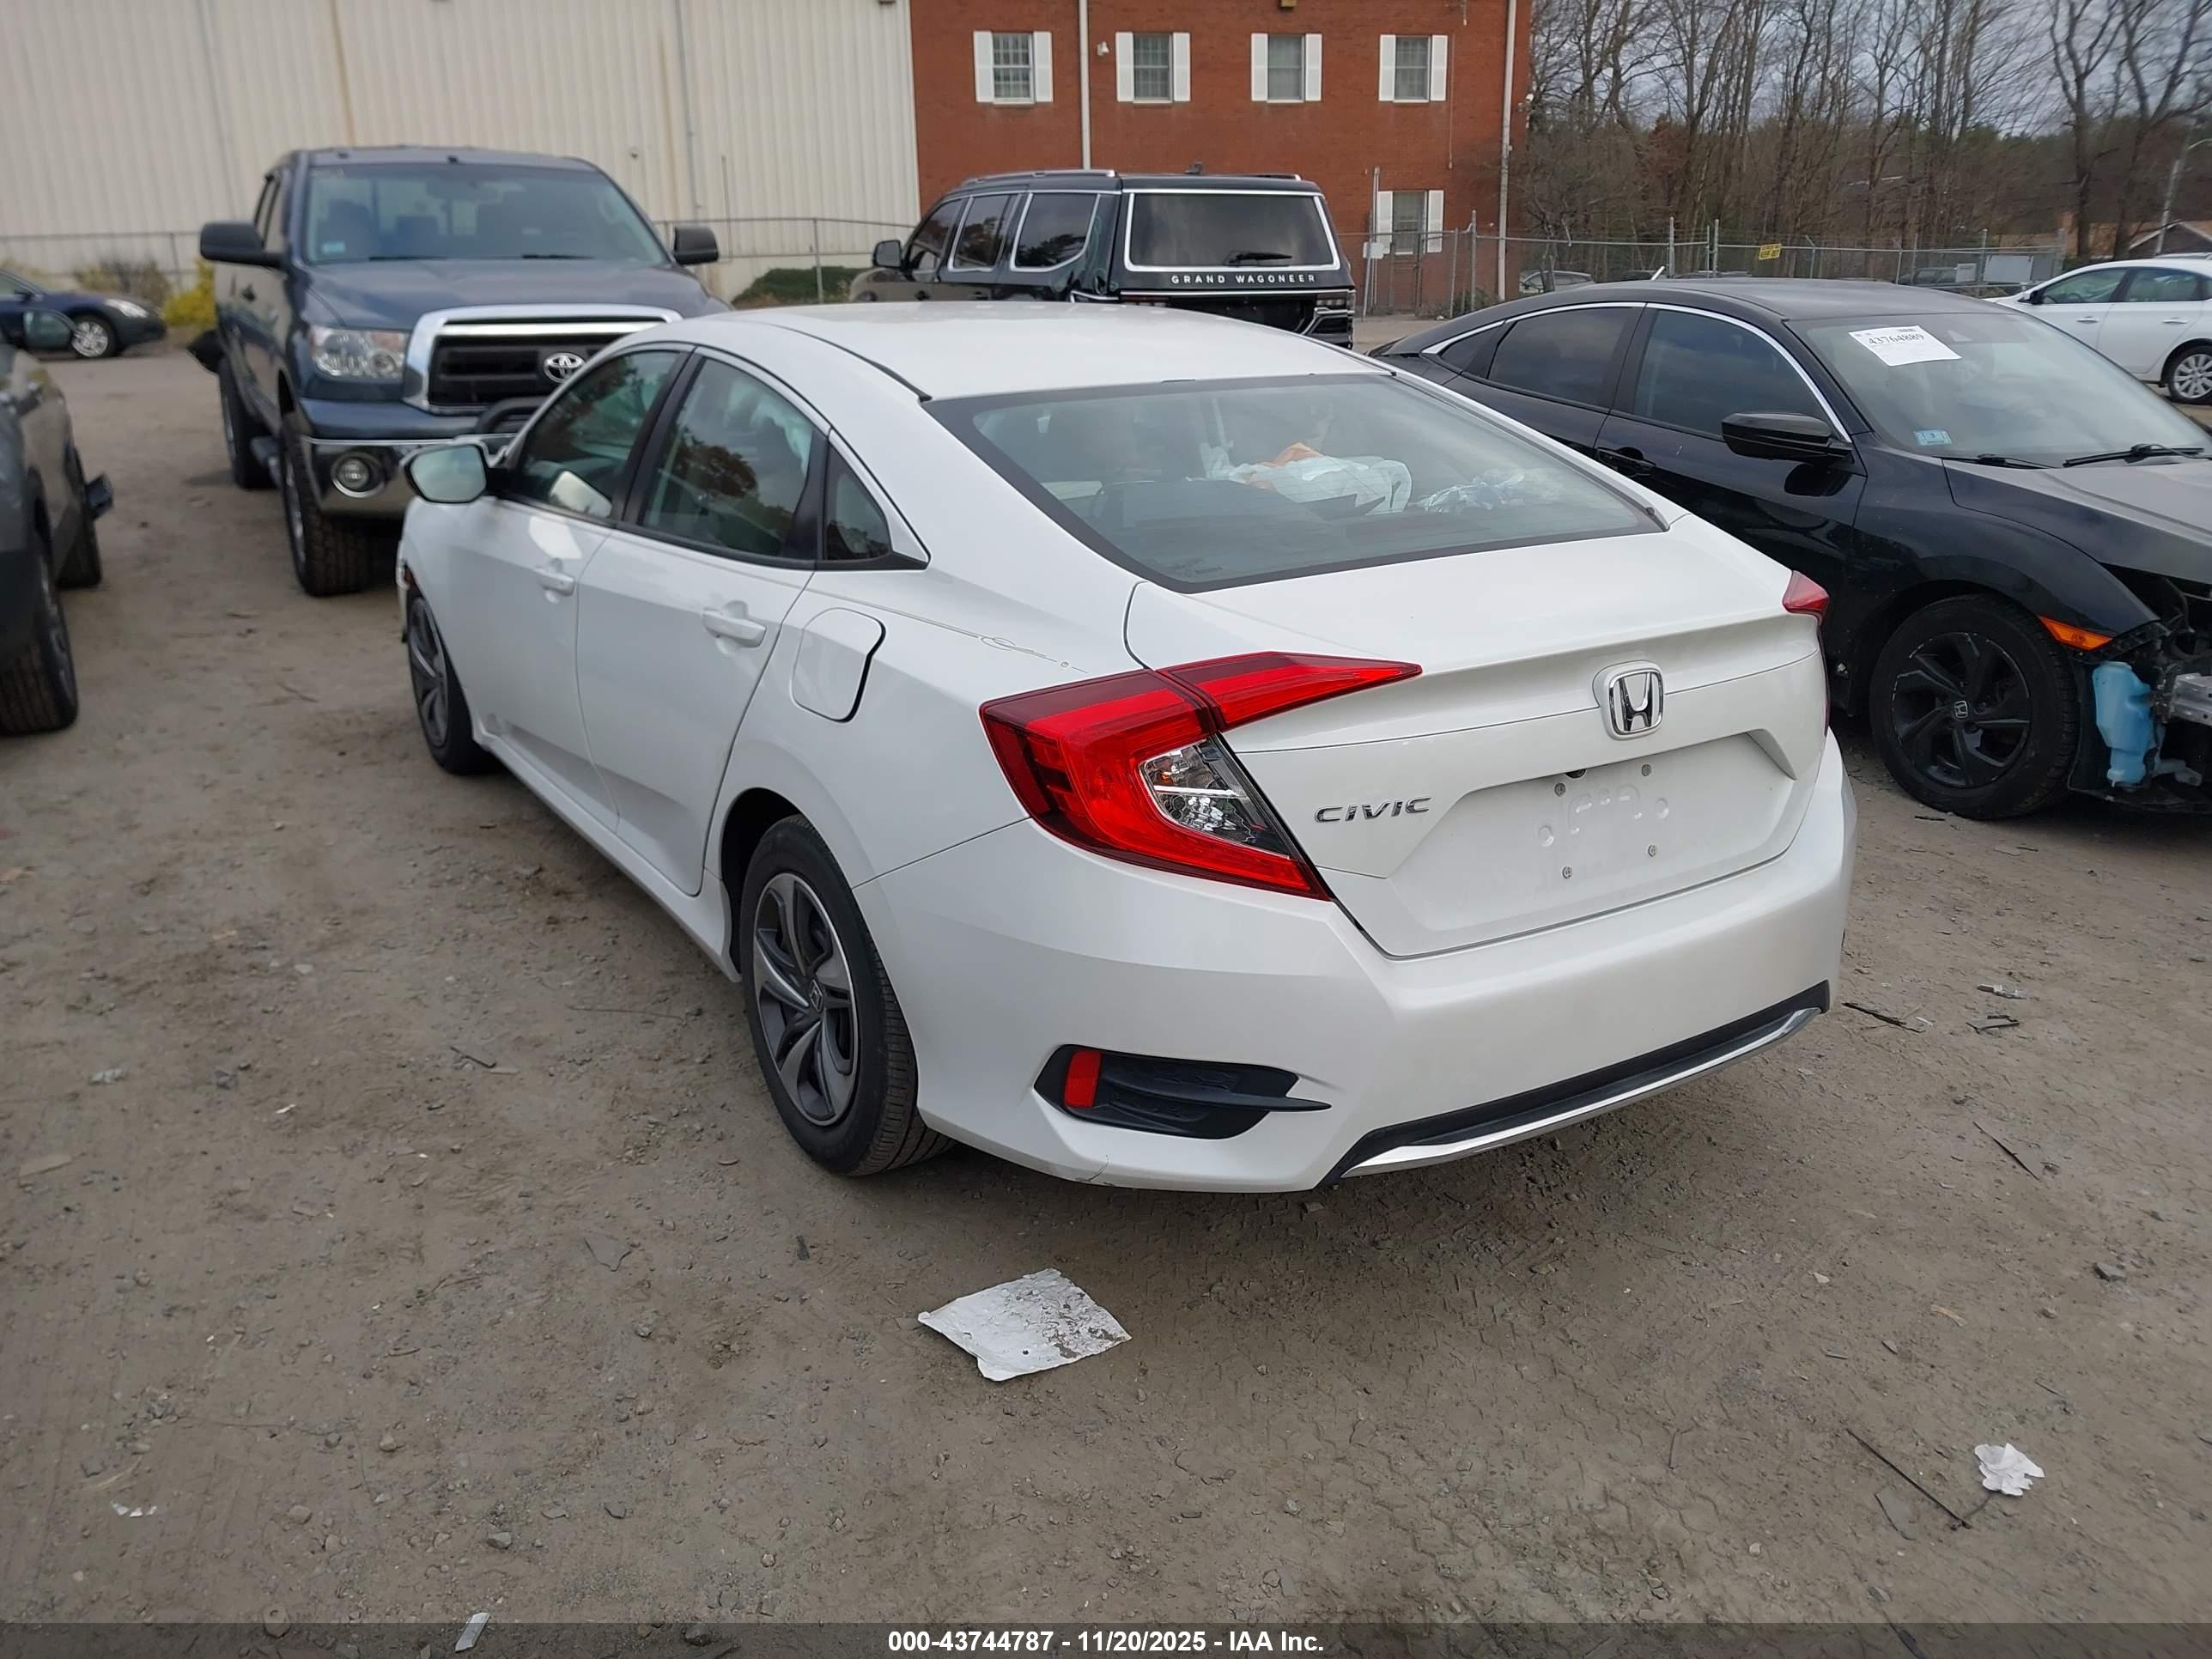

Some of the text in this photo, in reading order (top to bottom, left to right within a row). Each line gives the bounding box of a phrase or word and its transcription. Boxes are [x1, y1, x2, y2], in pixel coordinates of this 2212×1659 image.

[1170, 274, 1316, 284] GRAND WAGONEER
[1315, 797, 1431, 823] CIVIC
